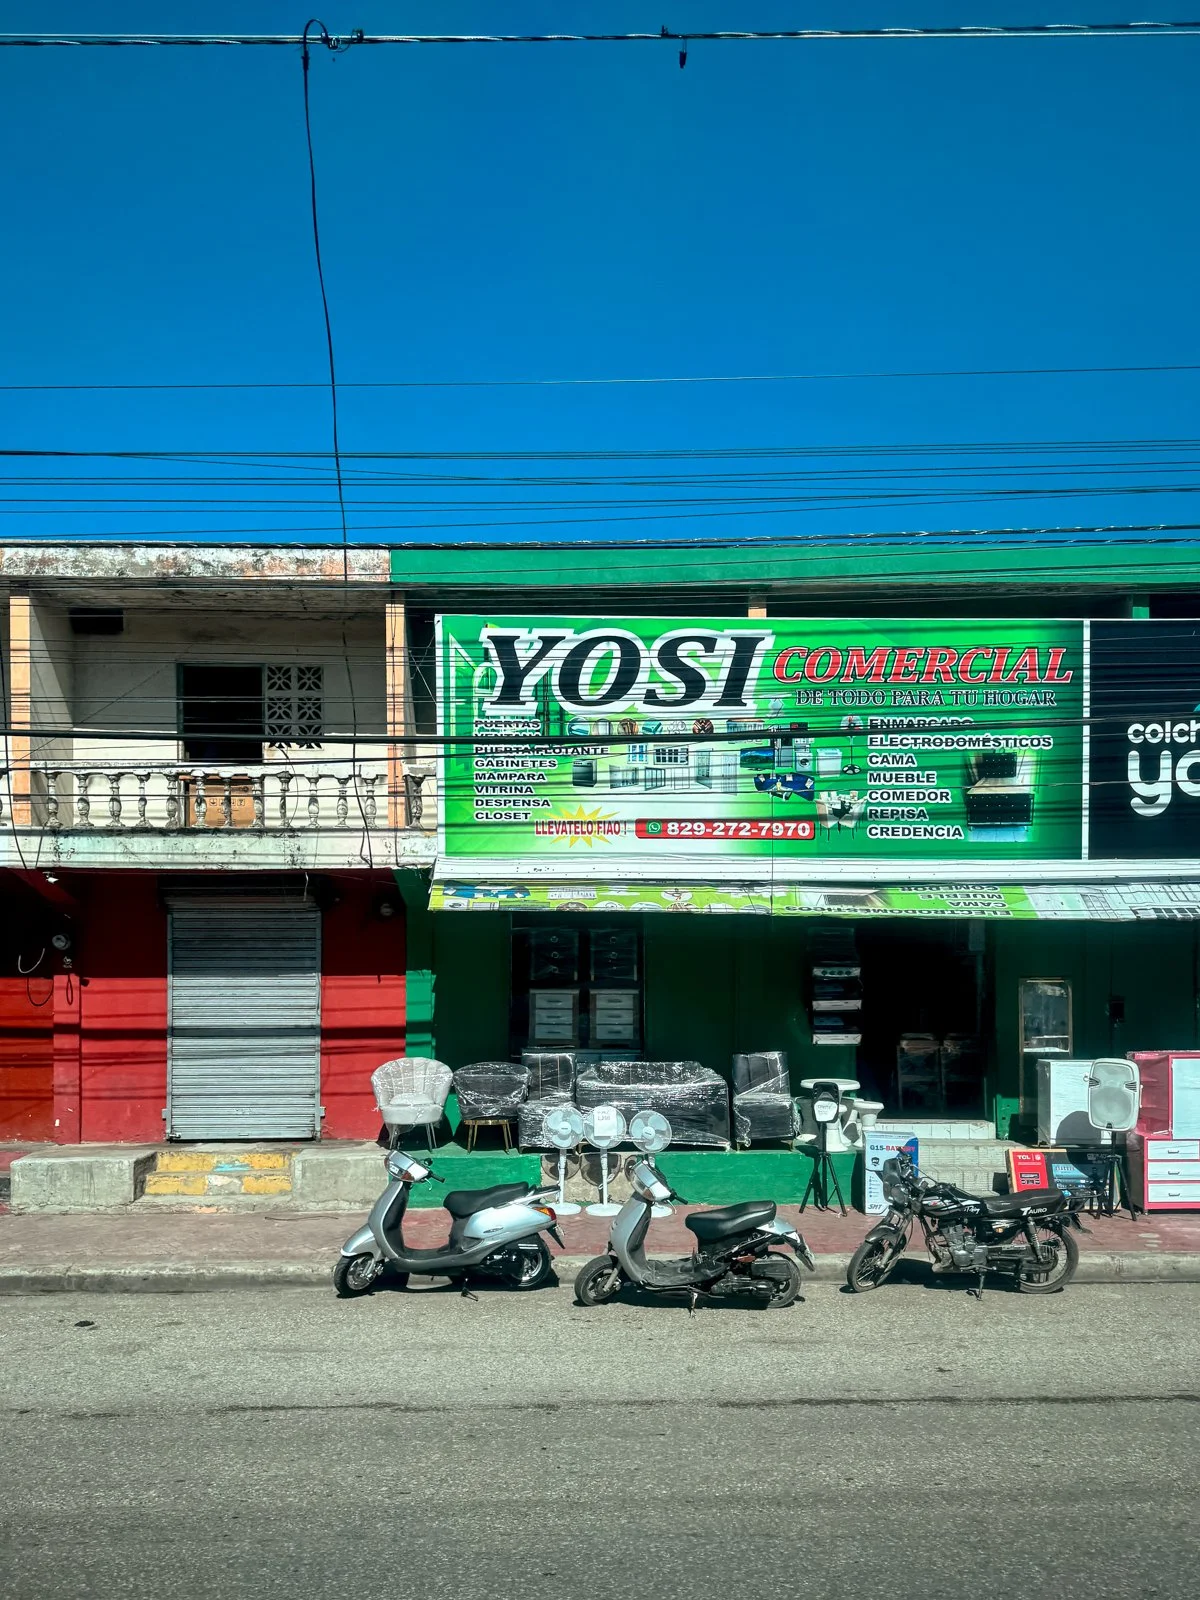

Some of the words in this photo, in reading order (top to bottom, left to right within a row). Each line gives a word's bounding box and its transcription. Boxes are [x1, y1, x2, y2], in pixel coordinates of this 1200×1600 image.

[485, 633, 767, 708] YOSI
[773, 647, 1073, 684] COMERCIAL
[796, 690, 823, 706] DE
[827, 690, 885, 706] TODO
[890, 690, 943, 706] PARA
[949, 690, 979, 706] TU
[983, 690, 1057, 706] HOGAR
[474, 720, 541, 729] PUERTAS
[868, 734, 1053, 749] ELECTRODOMÉSTICOS
[474, 746, 532, 755] PUERTA
[474, 759, 558, 768] GABINETES
[868, 754, 916, 766] CAMA
[474, 772, 547, 781] MAMPARA
[868, 772, 936, 783] MUEBLE
[474, 785, 534, 794] VITRINA
[868, 790, 951, 802] COMEDOR
[474, 798, 551, 807] DESPENSA
[474, 811, 532, 820] CLOSET
[868, 808, 929, 820] REPISA
[534, 820, 594, 836] LLEVATELO
[595, 820, 622, 836] FIAO
[666, 821, 811, 837] 829-272-7970
[868, 826, 963, 838] CREDENCIA
